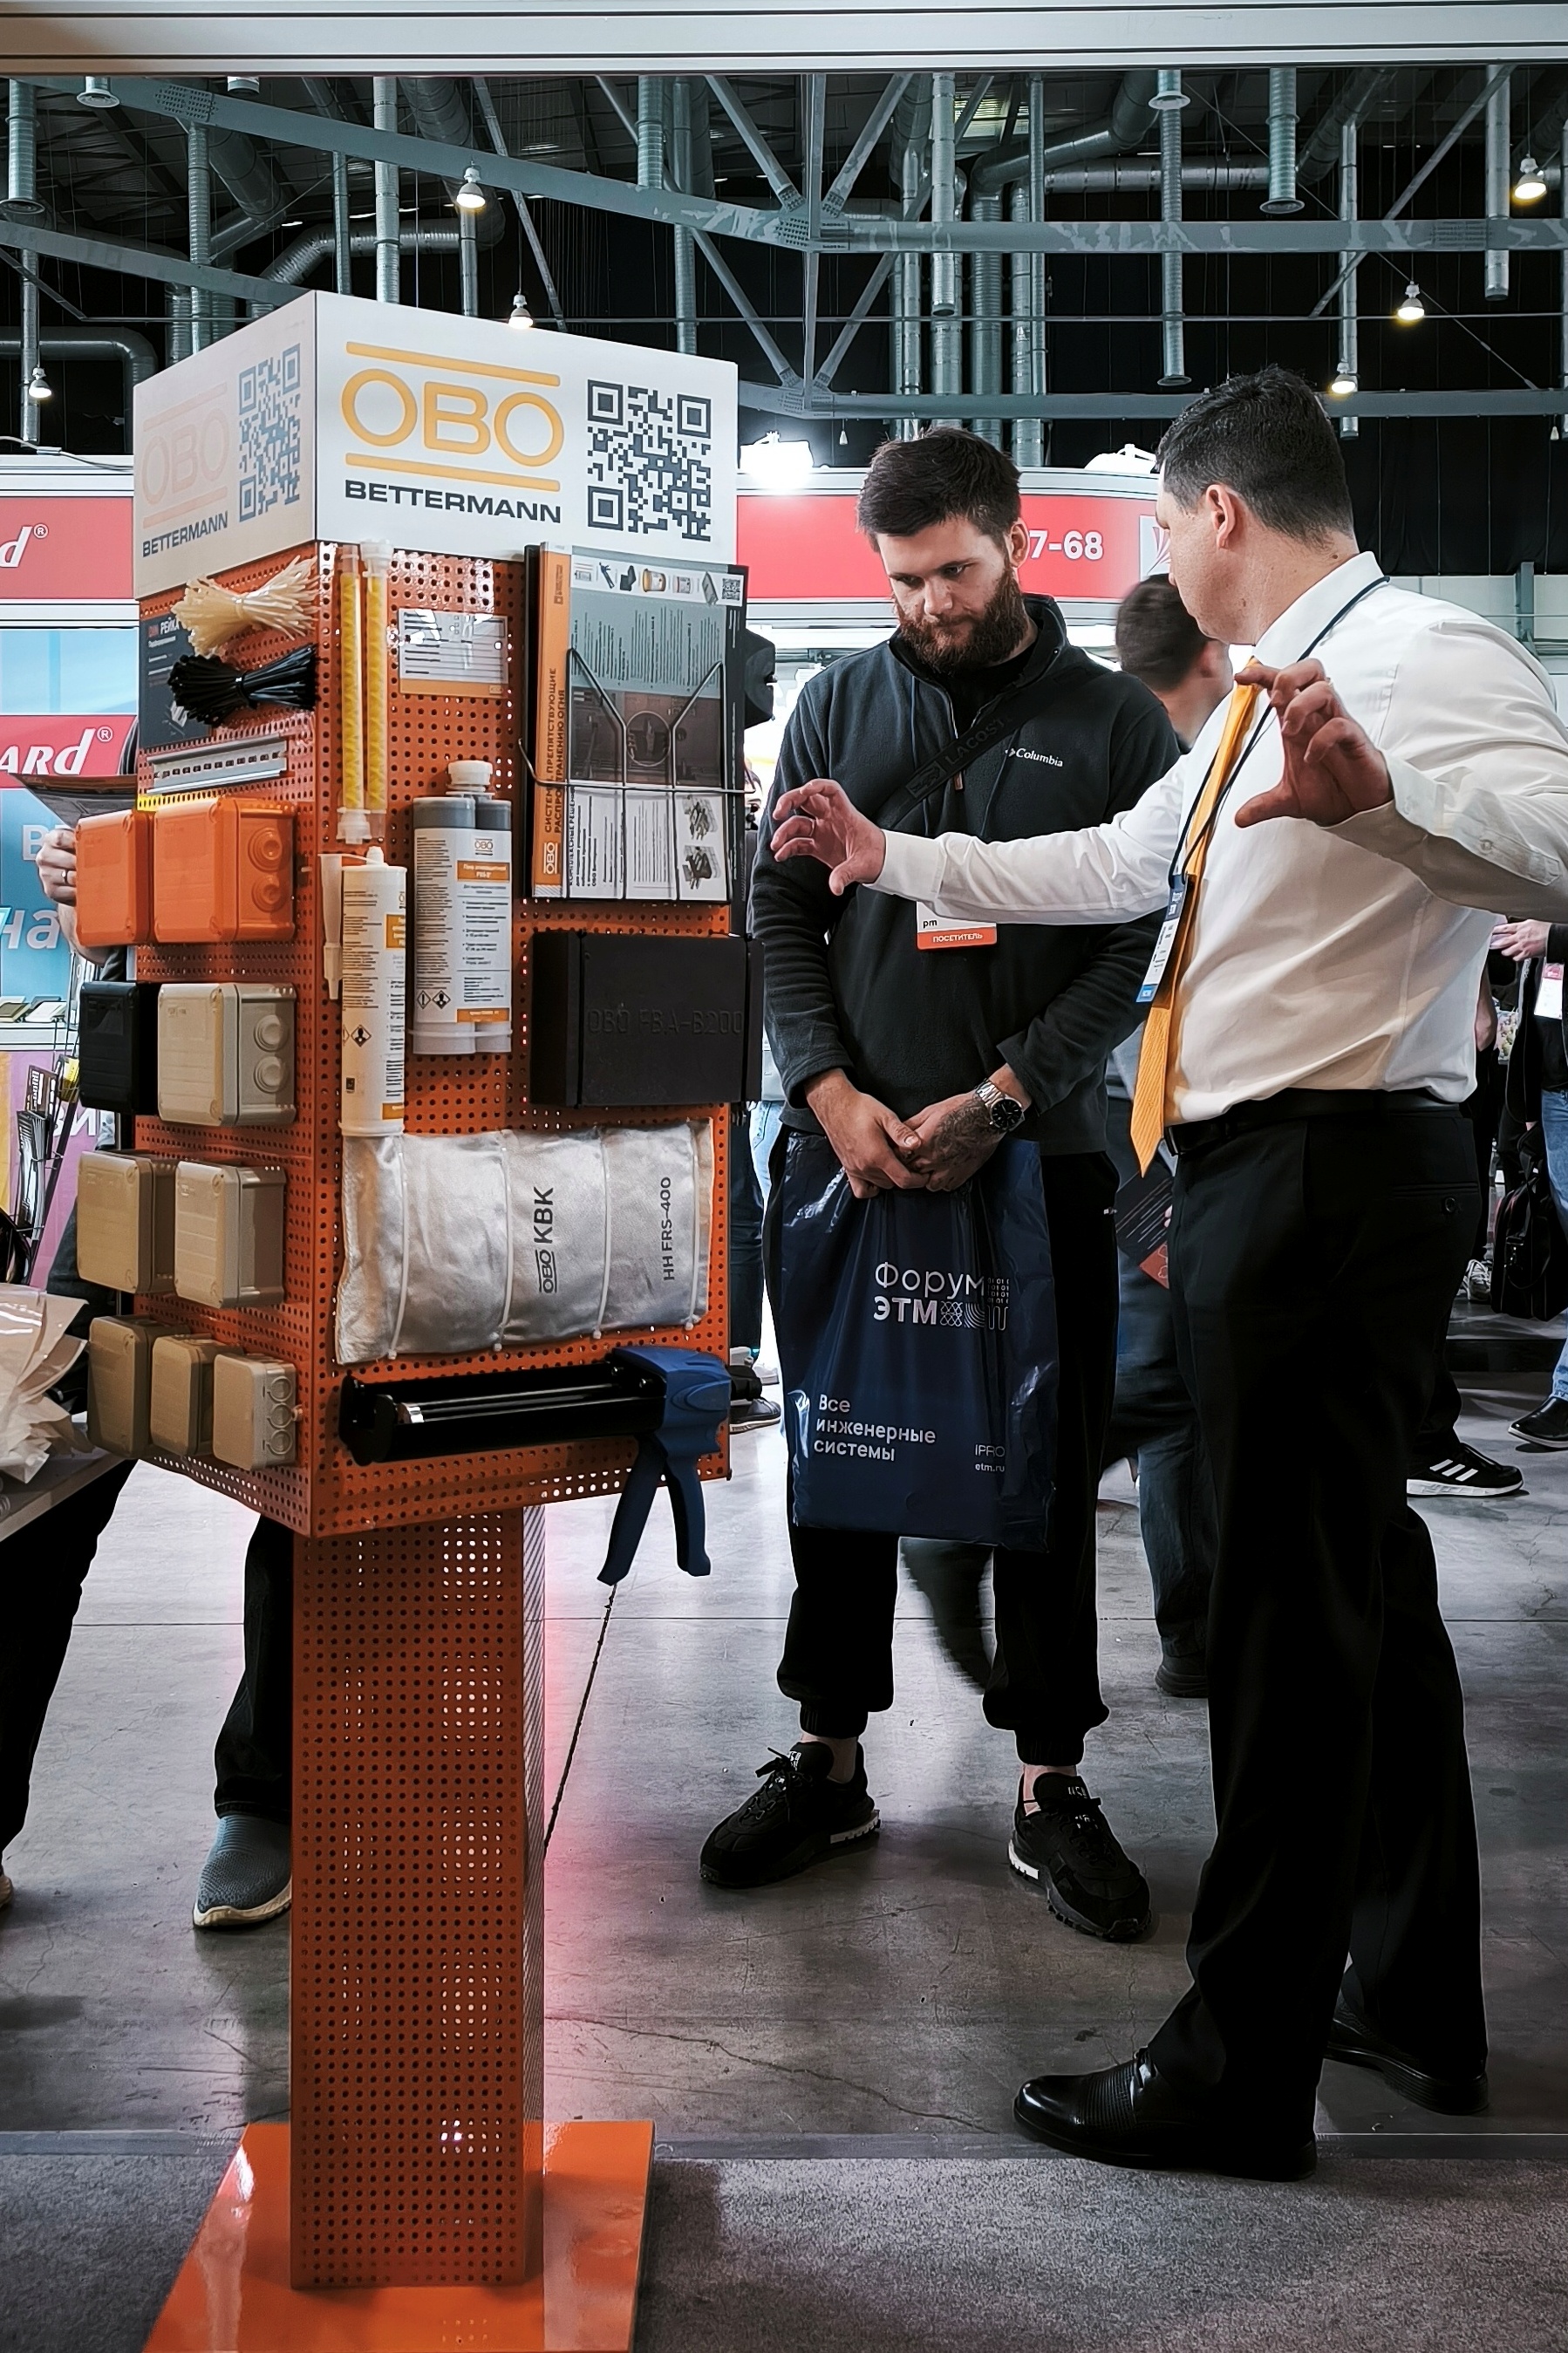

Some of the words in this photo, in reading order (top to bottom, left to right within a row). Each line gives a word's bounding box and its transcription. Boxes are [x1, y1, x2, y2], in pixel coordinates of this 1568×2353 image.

[341, 368, 565, 467] OBO
[141, 407, 229, 506] OBO
[344, 479, 561, 524] BETTERMANN
[142, 510, 228, 557] BETTERMANN
[1029, 529, 1103, 560] 7-68
[945, 716, 1012, 766] LACOST
[1015, 747, 1064, 767] Columbia
[554, 721, 565, 834] РАСПРОТРАНЕНИЮ
[545, 842, 556, 875] OBO
[932, 933, 983, 943] ПОСЕТИТЕЛЬ
[587, 1008, 631, 1033] OBO
[534, 1186, 554, 1244] KBK
[660, 1176, 672, 1251] FRS-400
[538, 1250, 556, 1293] OBO
[663, 1255, 675, 1281] HH
[875, 1261, 985, 1299] Форум
[873, 1296, 937, 1325] ЭТМ
[819, 1394, 851, 1413] Все
[815, 1418, 937, 1444] инженерные
[814, 1439, 896, 1462] системы
